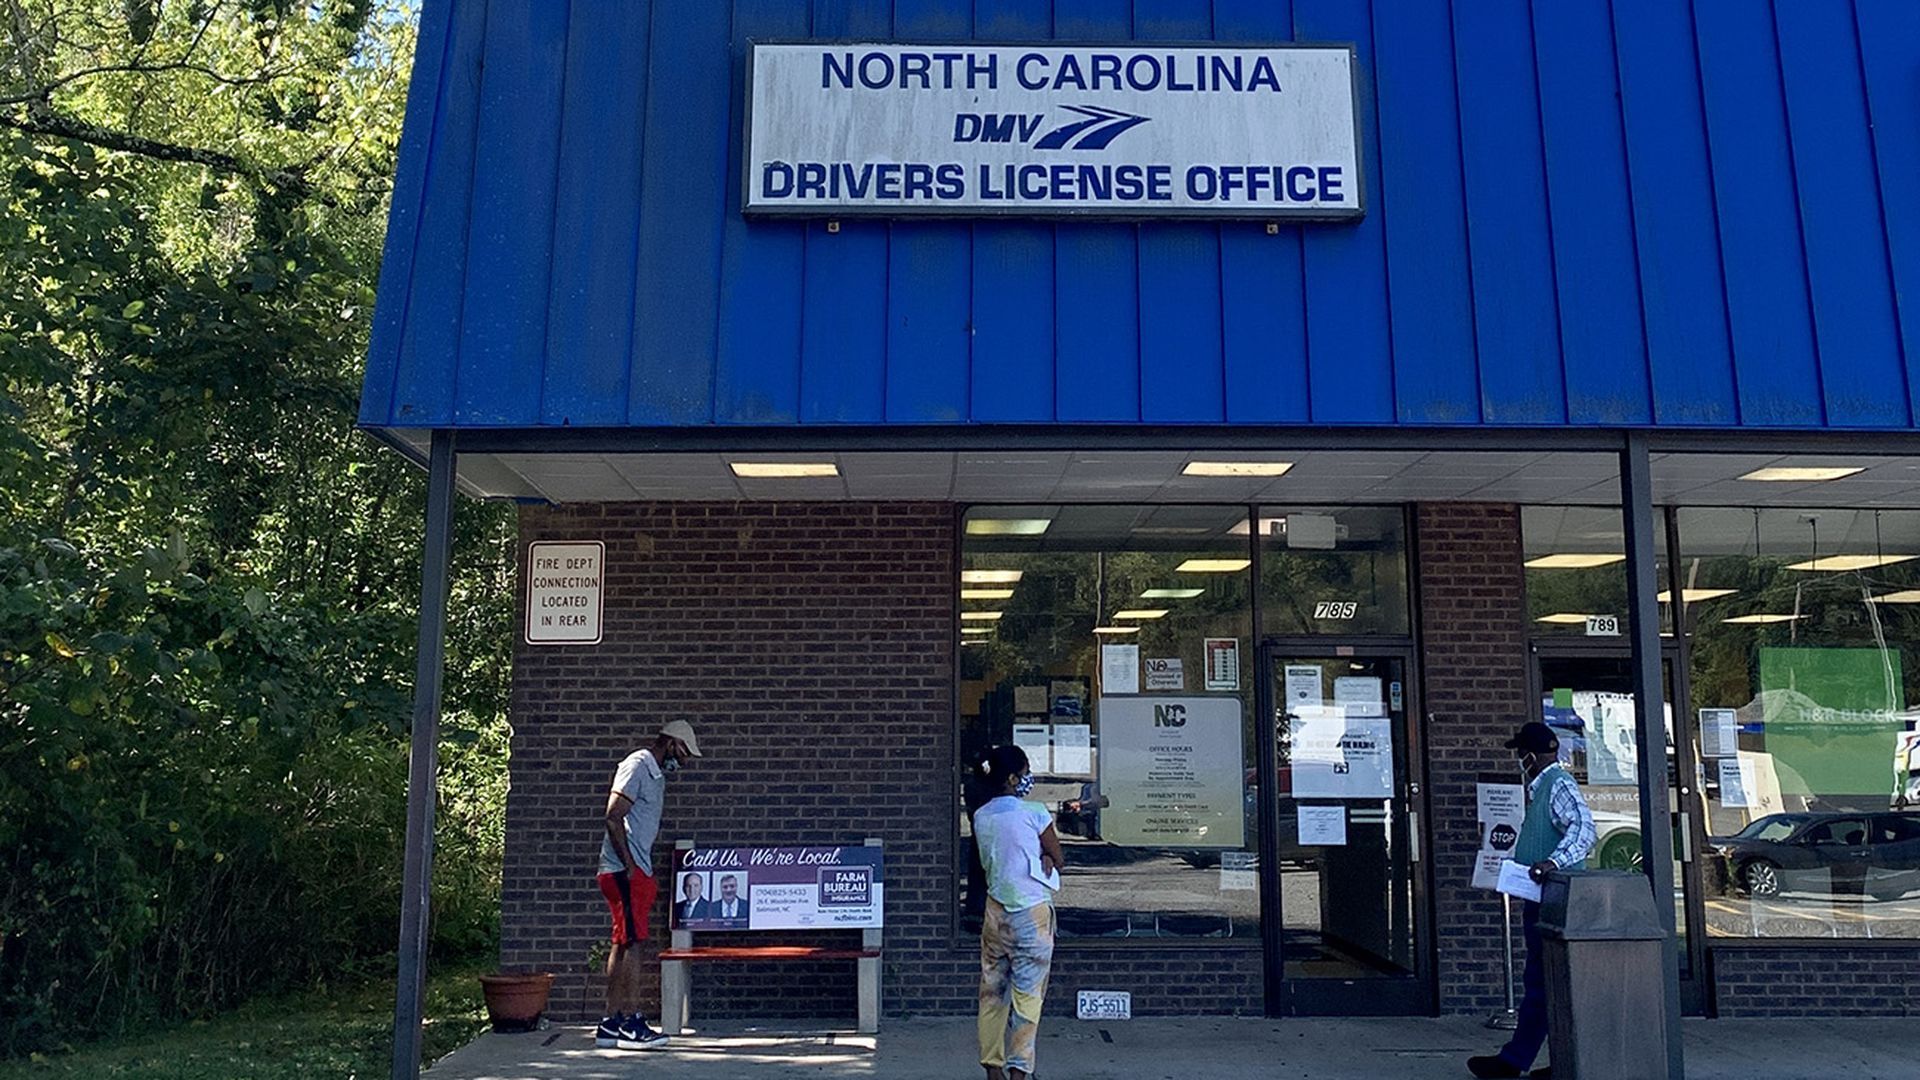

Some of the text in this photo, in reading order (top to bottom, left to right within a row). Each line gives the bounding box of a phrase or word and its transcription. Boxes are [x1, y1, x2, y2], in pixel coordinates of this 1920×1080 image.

[822, 52, 1282, 93] NORTH CAROLINA
[953, 113, 1045, 143] DMV
[762, 162, 1345, 202] DRIVERS LICENSE OFFICE
[536, 558, 560, 570] FIRE
[532, 577, 599, 589] CONNECTION
[541, 596, 589, 608] LOCATED
[1317, 602, 1355, 618] 785
[541, 615, 587, 626] IN REAR
[1590, 618, 1615, 632] 789
[1153, 704, 1187, 728] NC
[1841, 707, 1898, 722] BLOCK
[1582, 792, 1639, 801] LK-INS WELC
[1491, 831, 1516, 844] STOP
[682, 847, 842, 867] Call Us. We're Local.
[836, 872, 867, 882] FARM
[823, 882, 867, 893] BUREAU
